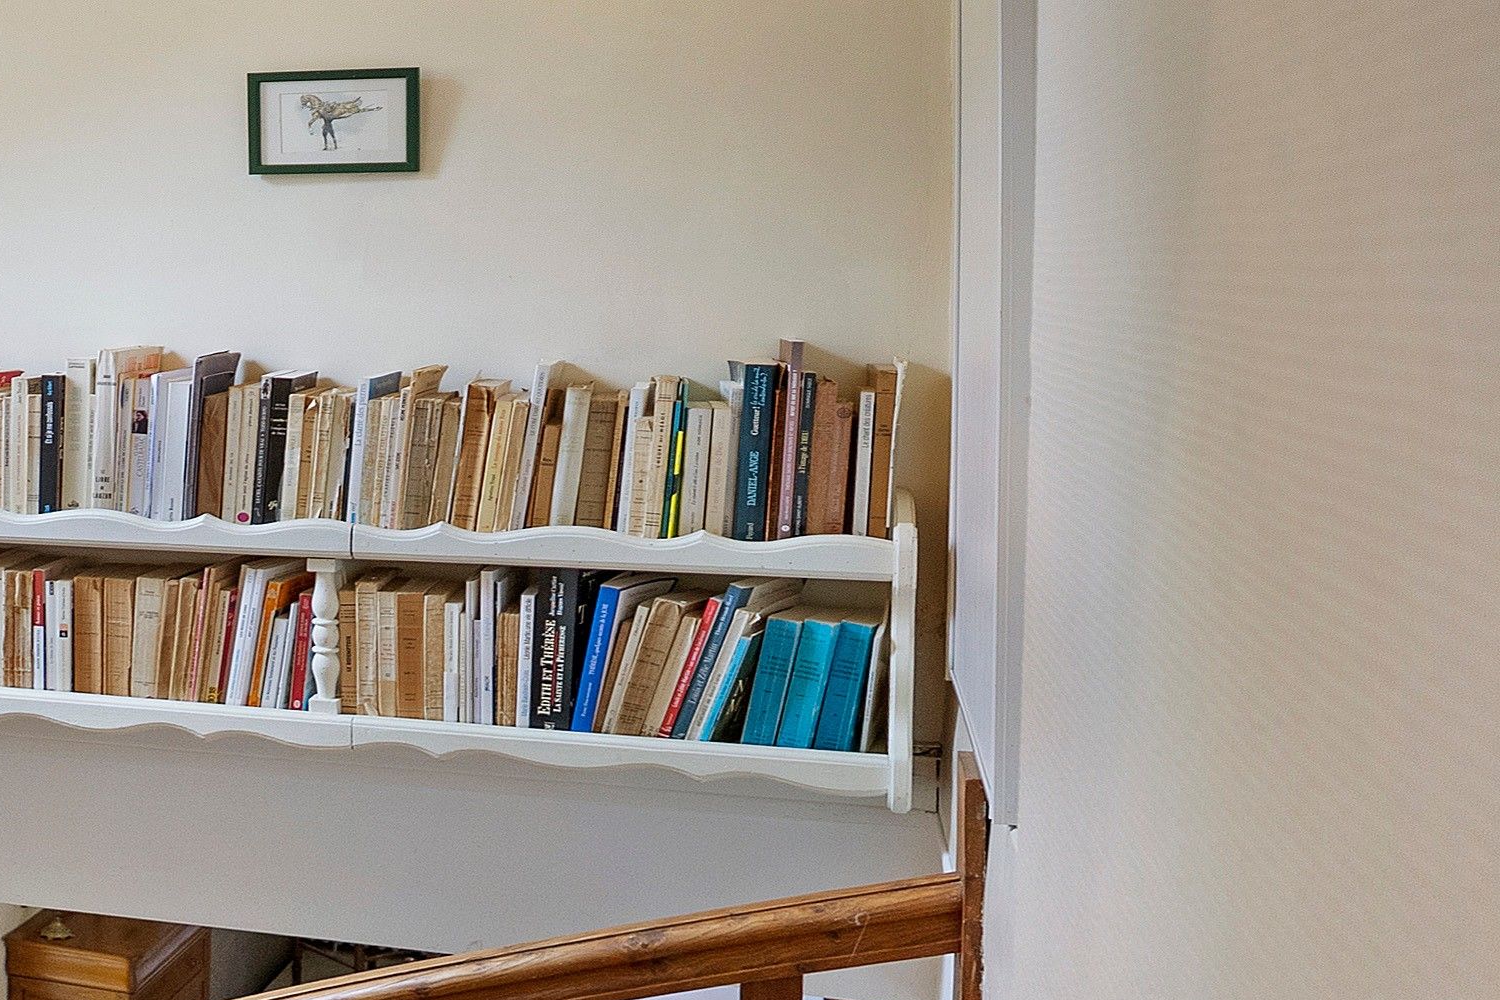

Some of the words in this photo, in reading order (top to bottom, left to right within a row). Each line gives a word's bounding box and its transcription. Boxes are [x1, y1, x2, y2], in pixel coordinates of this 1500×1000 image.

[358, 383, 367, 406] pierres
[355, 419, 363, 438] clarté
[751, 406, 761, 436] Guetteur!
[354, 438, 361, 446] La
[747, 450, 760, 506] DANIEL-ANGE
[540, 619, 556, 667] THÉRÈSE
[542, 668, 552, 680] ET
[556, 663, 565, 672] LA
[556, 672, 564, 681] ET
[687, 684, 701, 704] Louis
[696, 662, 710, 680] Zélie
[703, 640, 718, 664] Martin
[537, 683, 551, 716] EDITH
[555, 681, 564, 703] SAINTE
[552, 704, 561, 713] LA
